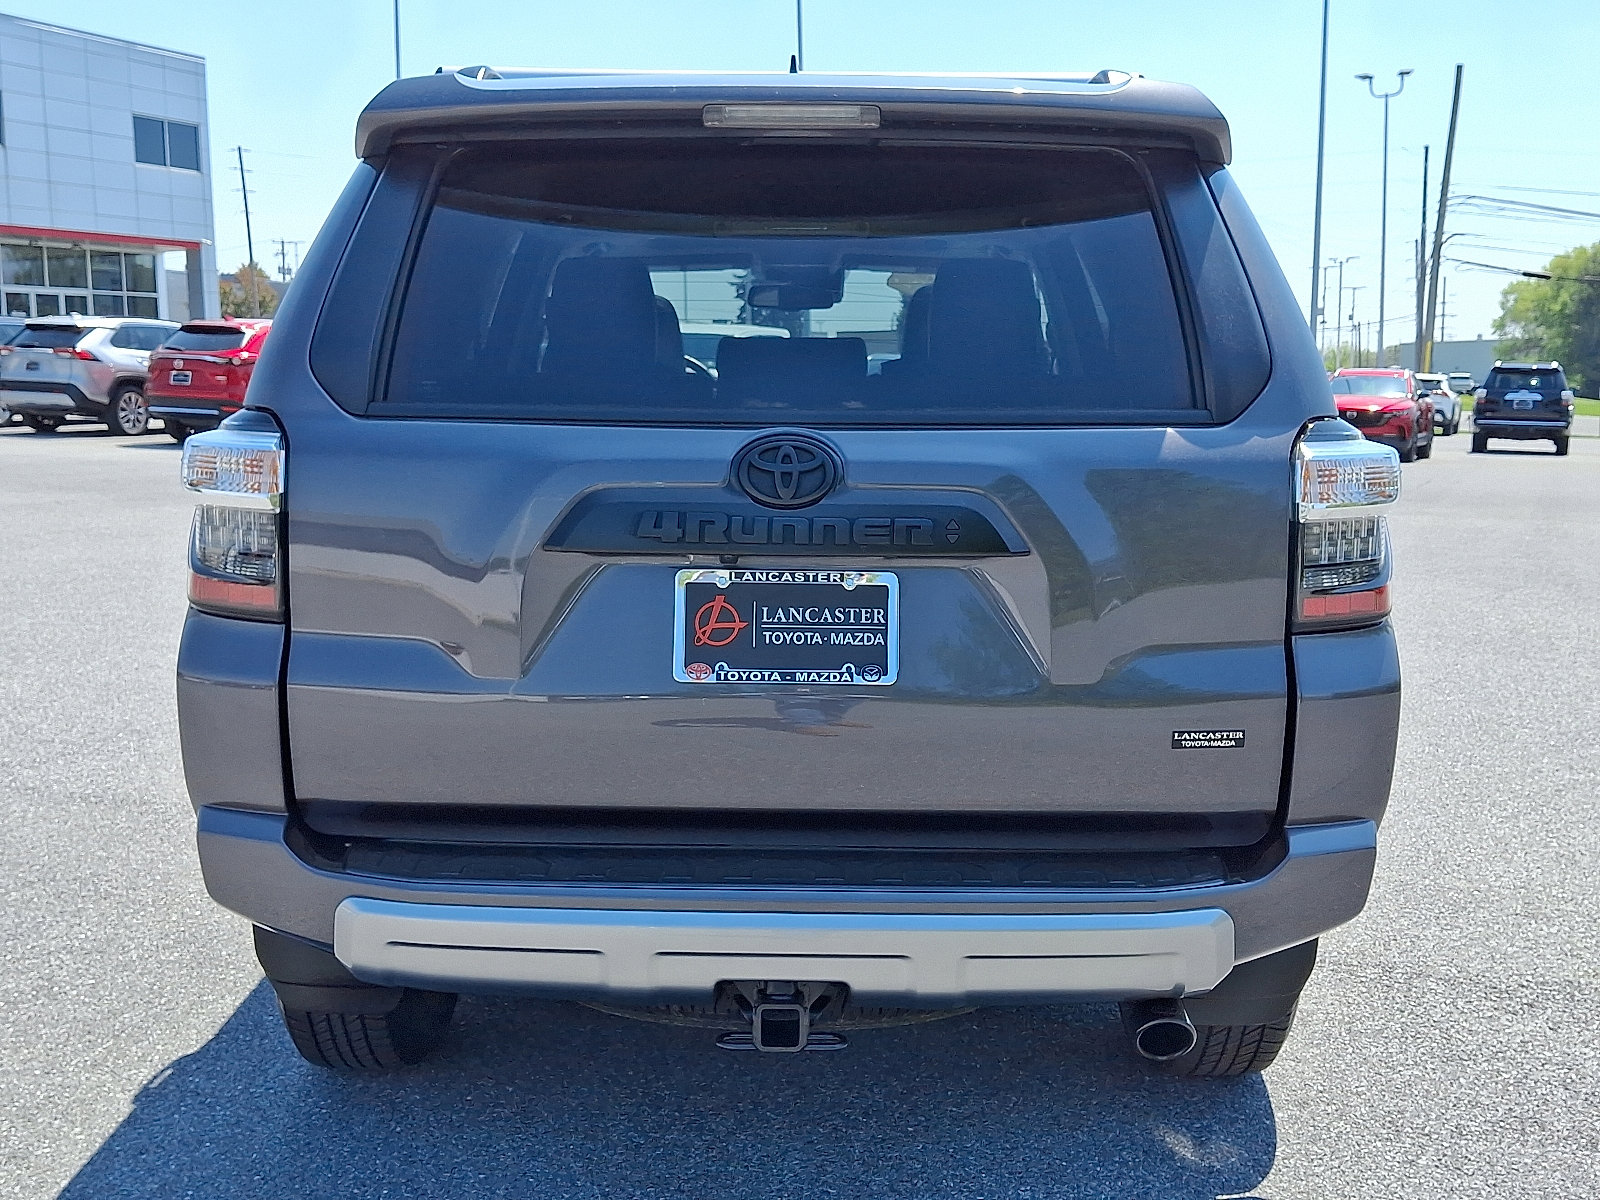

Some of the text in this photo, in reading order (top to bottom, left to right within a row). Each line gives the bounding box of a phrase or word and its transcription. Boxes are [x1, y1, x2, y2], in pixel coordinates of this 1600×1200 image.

[731, 572, 842, 583] LANCASTER
[761, 606, 886, 624] LANCASTER
[718, 671, 782, 681] TOYOTA
[795, 671, 852, 682] MAZDA
[1174, 732, 1244, 740] LANCASTER
